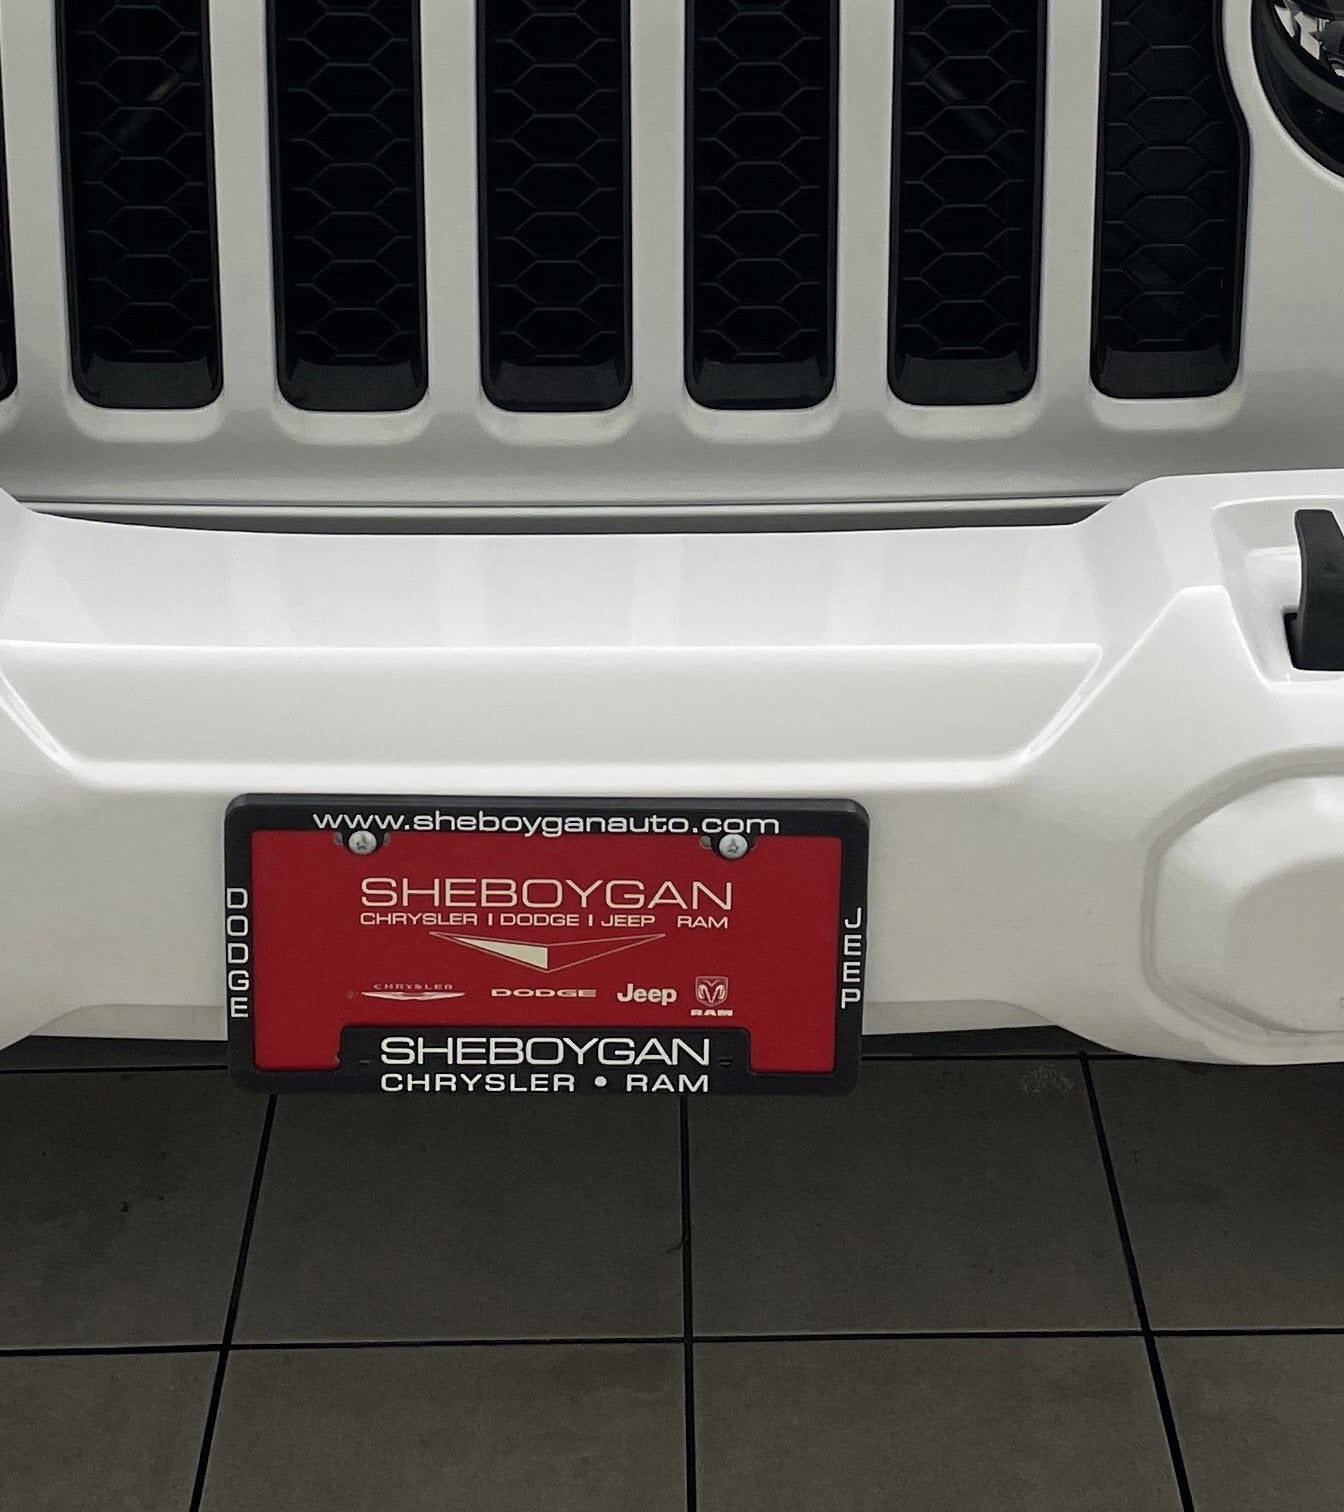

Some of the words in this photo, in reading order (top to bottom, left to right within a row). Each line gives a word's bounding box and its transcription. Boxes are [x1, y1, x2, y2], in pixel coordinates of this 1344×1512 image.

[312, 810, 780, 838] www.sheboyganauto.com
[360, 877, 732, 910] SHEBOYGAN
[359, 912, 478, 926] CHRYSLER
[500, 913, 580, 927] DODGE
[600, 914, 656, 927] JEEP
[677, 915, 729, 929] RAM
[226, 887, 250, 1018] DODGE
[840, 907, 862, 1009] JEEP
[491, 988, 597, 997] DODGE
[616, 983, 678, 1006] Jeep
[690, 1009, 734, 1017] RAM
[380, 1036, 710, 1066] SHEBOYGAN
[380, 1073, 575, 1092] CHRYSLER
[626, 1074, 709, 1093] RAM
